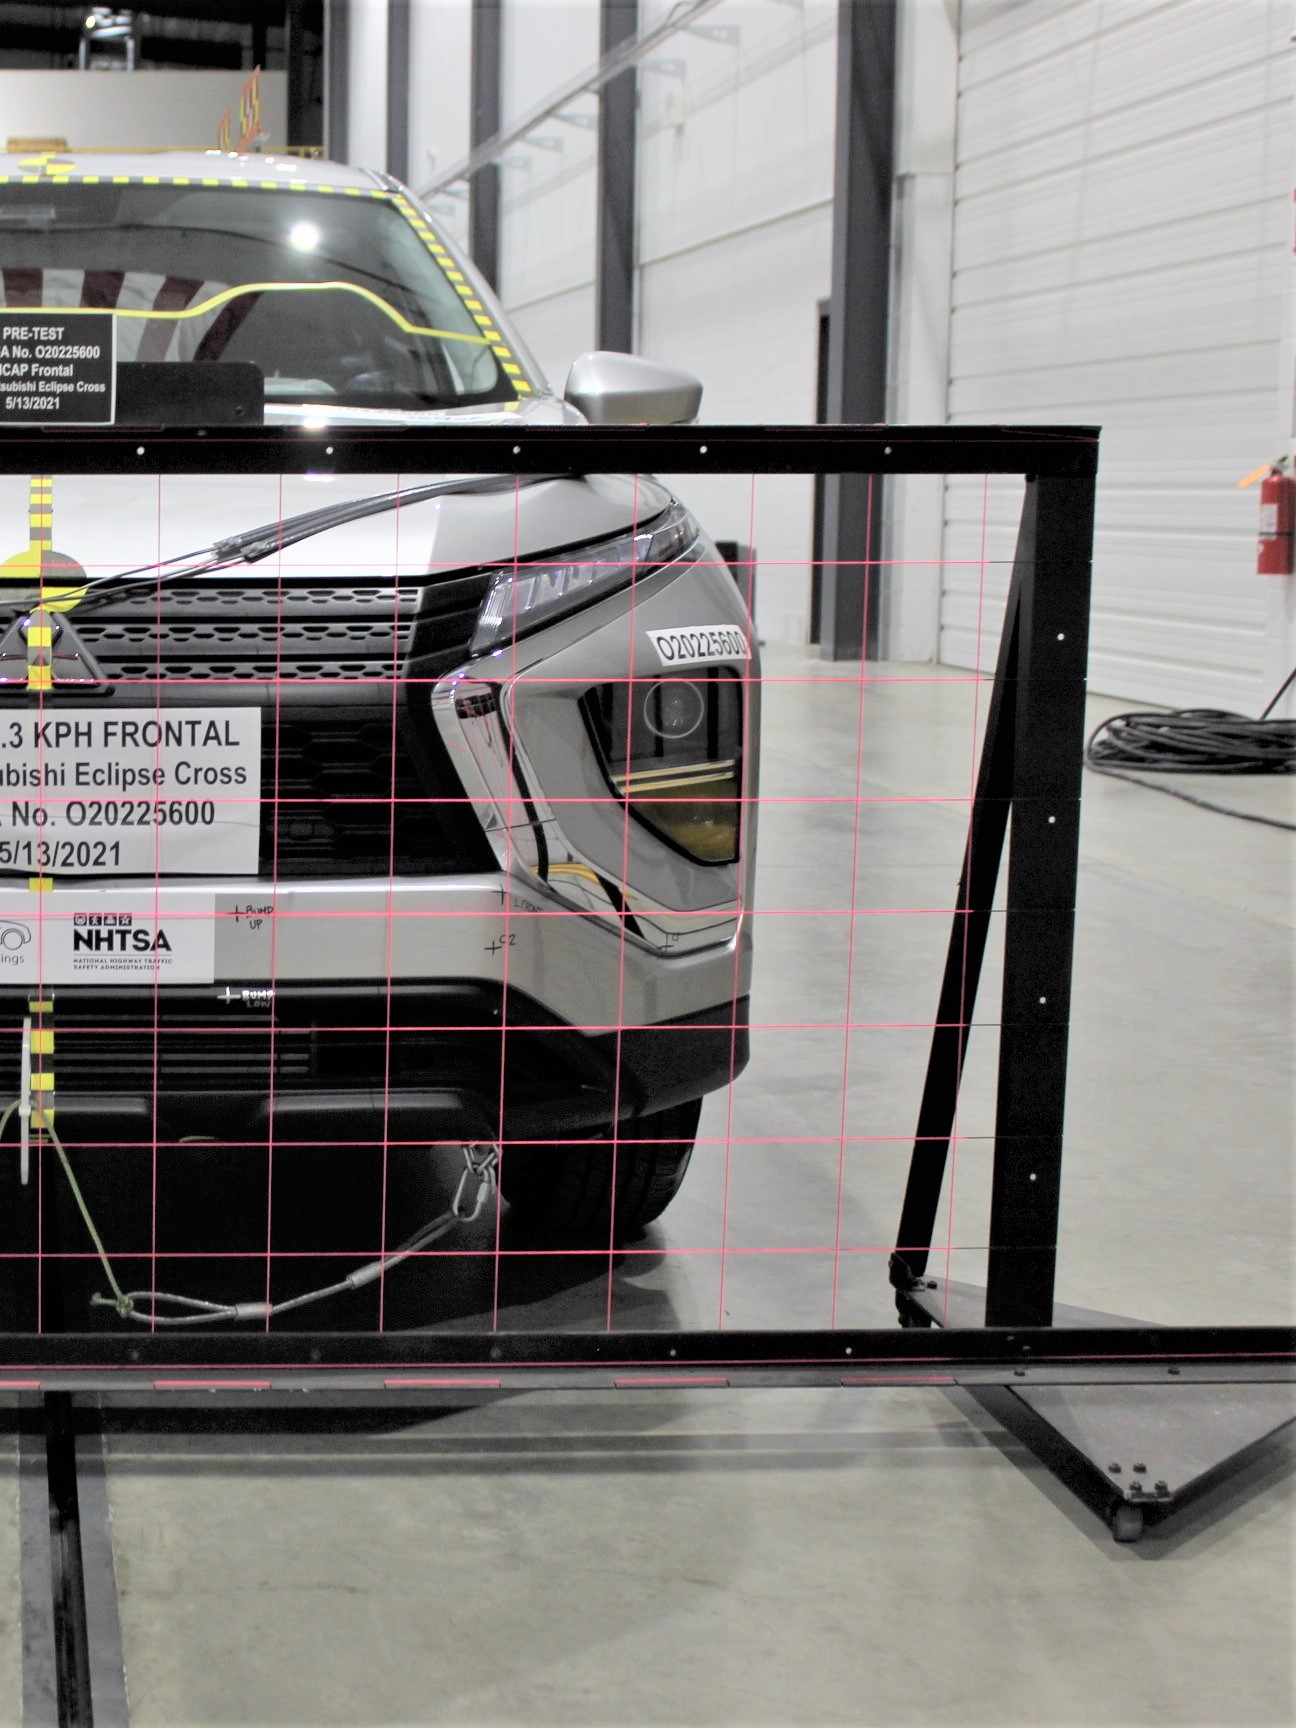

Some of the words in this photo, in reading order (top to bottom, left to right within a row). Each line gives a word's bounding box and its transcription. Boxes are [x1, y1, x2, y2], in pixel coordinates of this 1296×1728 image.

[3, 327, 64, 340] PRE-TEST
[12, 346, 32, 358] No.
[31, 364, 74, 377] Frontal
[38, 381, 74, 394] Eclipse
[76, 381, 106, 392] Cross
[5, 397, 60, 410] 5/13/2021
[33, 721, 92, 748] KPH
[103, 720, 240, 748] FRONTAL
[75, 762, 165, 792] Eclipse
[175, 761, 247, 785] Cross
[12, 801, 55, 827] No.
[249, 919, 263, 930] UP
[74, 929, 172, 951] NHTSA
[499, 934, 516, 946] C2
